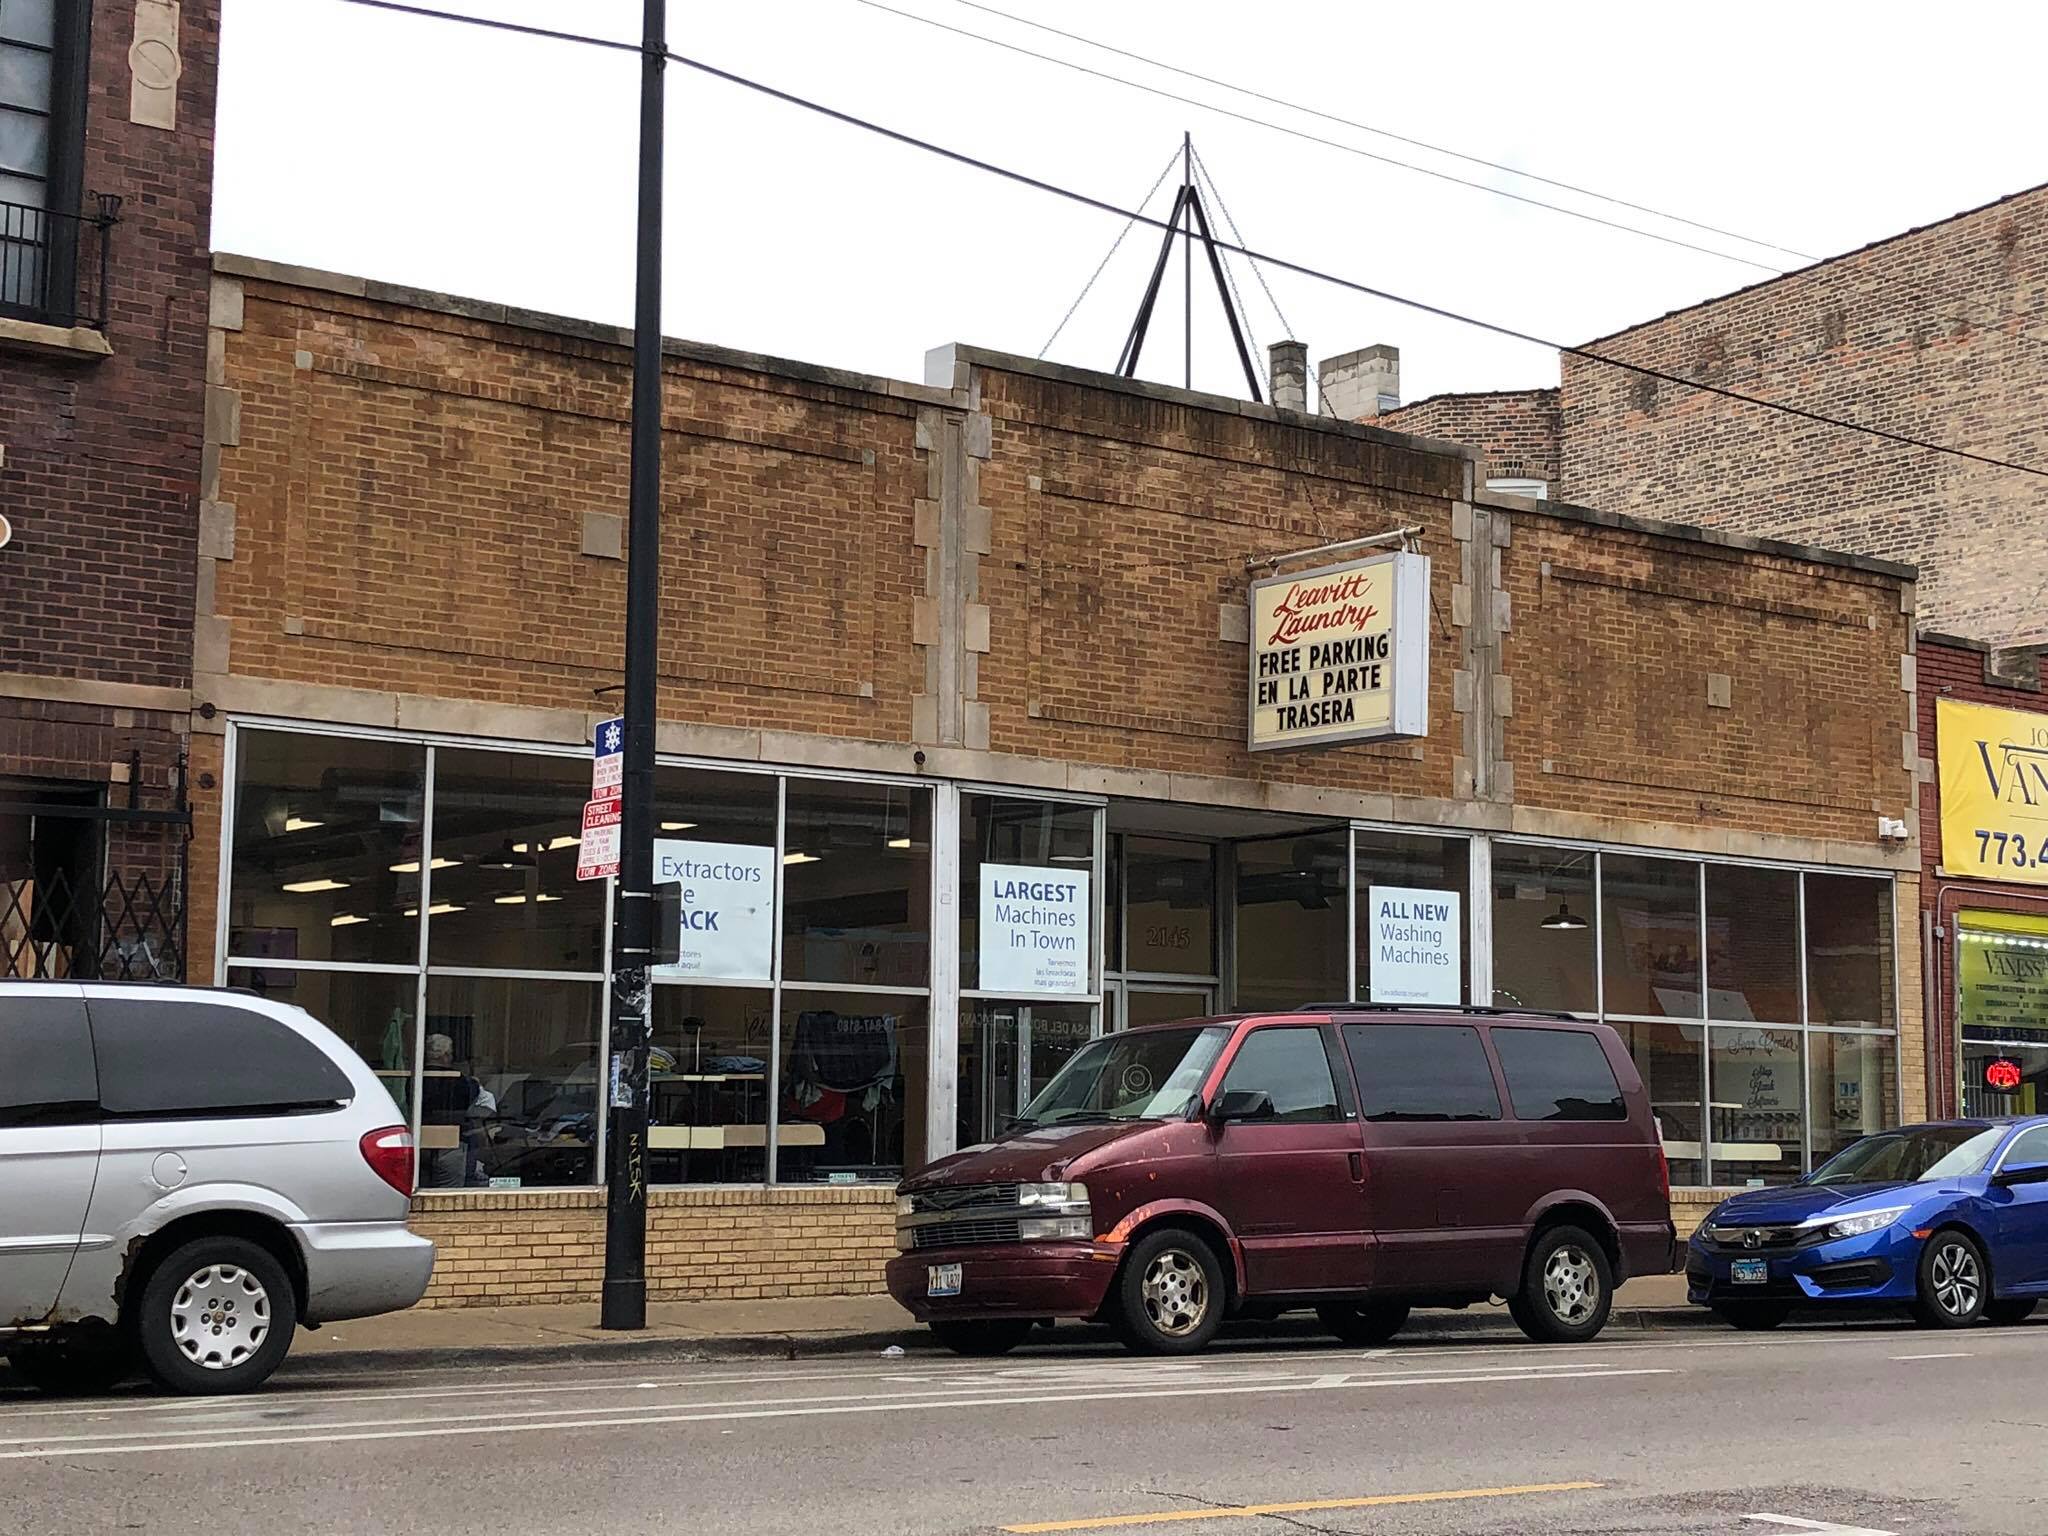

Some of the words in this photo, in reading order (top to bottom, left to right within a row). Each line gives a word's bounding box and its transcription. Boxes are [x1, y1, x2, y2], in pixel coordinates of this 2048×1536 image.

[1273, 573, 1374, 618] Leavitt
[1268, 603, 1379, 646] Laundry
[1259, 648, 1300, 677] FREE
[1309, 633, 1389, 670] PARKING
[1258, 680, 1278, 705] EN
[1289, 675, 1310, 701] LA
[1323, 664, 1381, 697] PARTE
[1276, 698, 1355, 730] TRASERA
[594, 787, 607, 799] TOW
[585, 811, 622, 827] CLEANING
[587, 801, 613, 817] STREET
[580, 866, 596, 877] TOW
[597, 863, 618, 875] ZONE
[661, 855, 761, 882] Extractors
[994, 880, 1077, 903] LARGEST
[680, 910, 719, 931] ACK
[995, 904, 1076, 927] Machines
[1380, 901, 1409, 919] ALL
[1413, 903, 1449, 922] NEW
[1011, 929, 1026, 948] In
[1030, 930, 1075, 950] Town
[1146, 926, 1191, 948] 2145
[1380, 923, 1442, 948] Washing
[1381, 945, 1449, 966] Machines
[1987, 1062, 2020, 1086] OPEN
